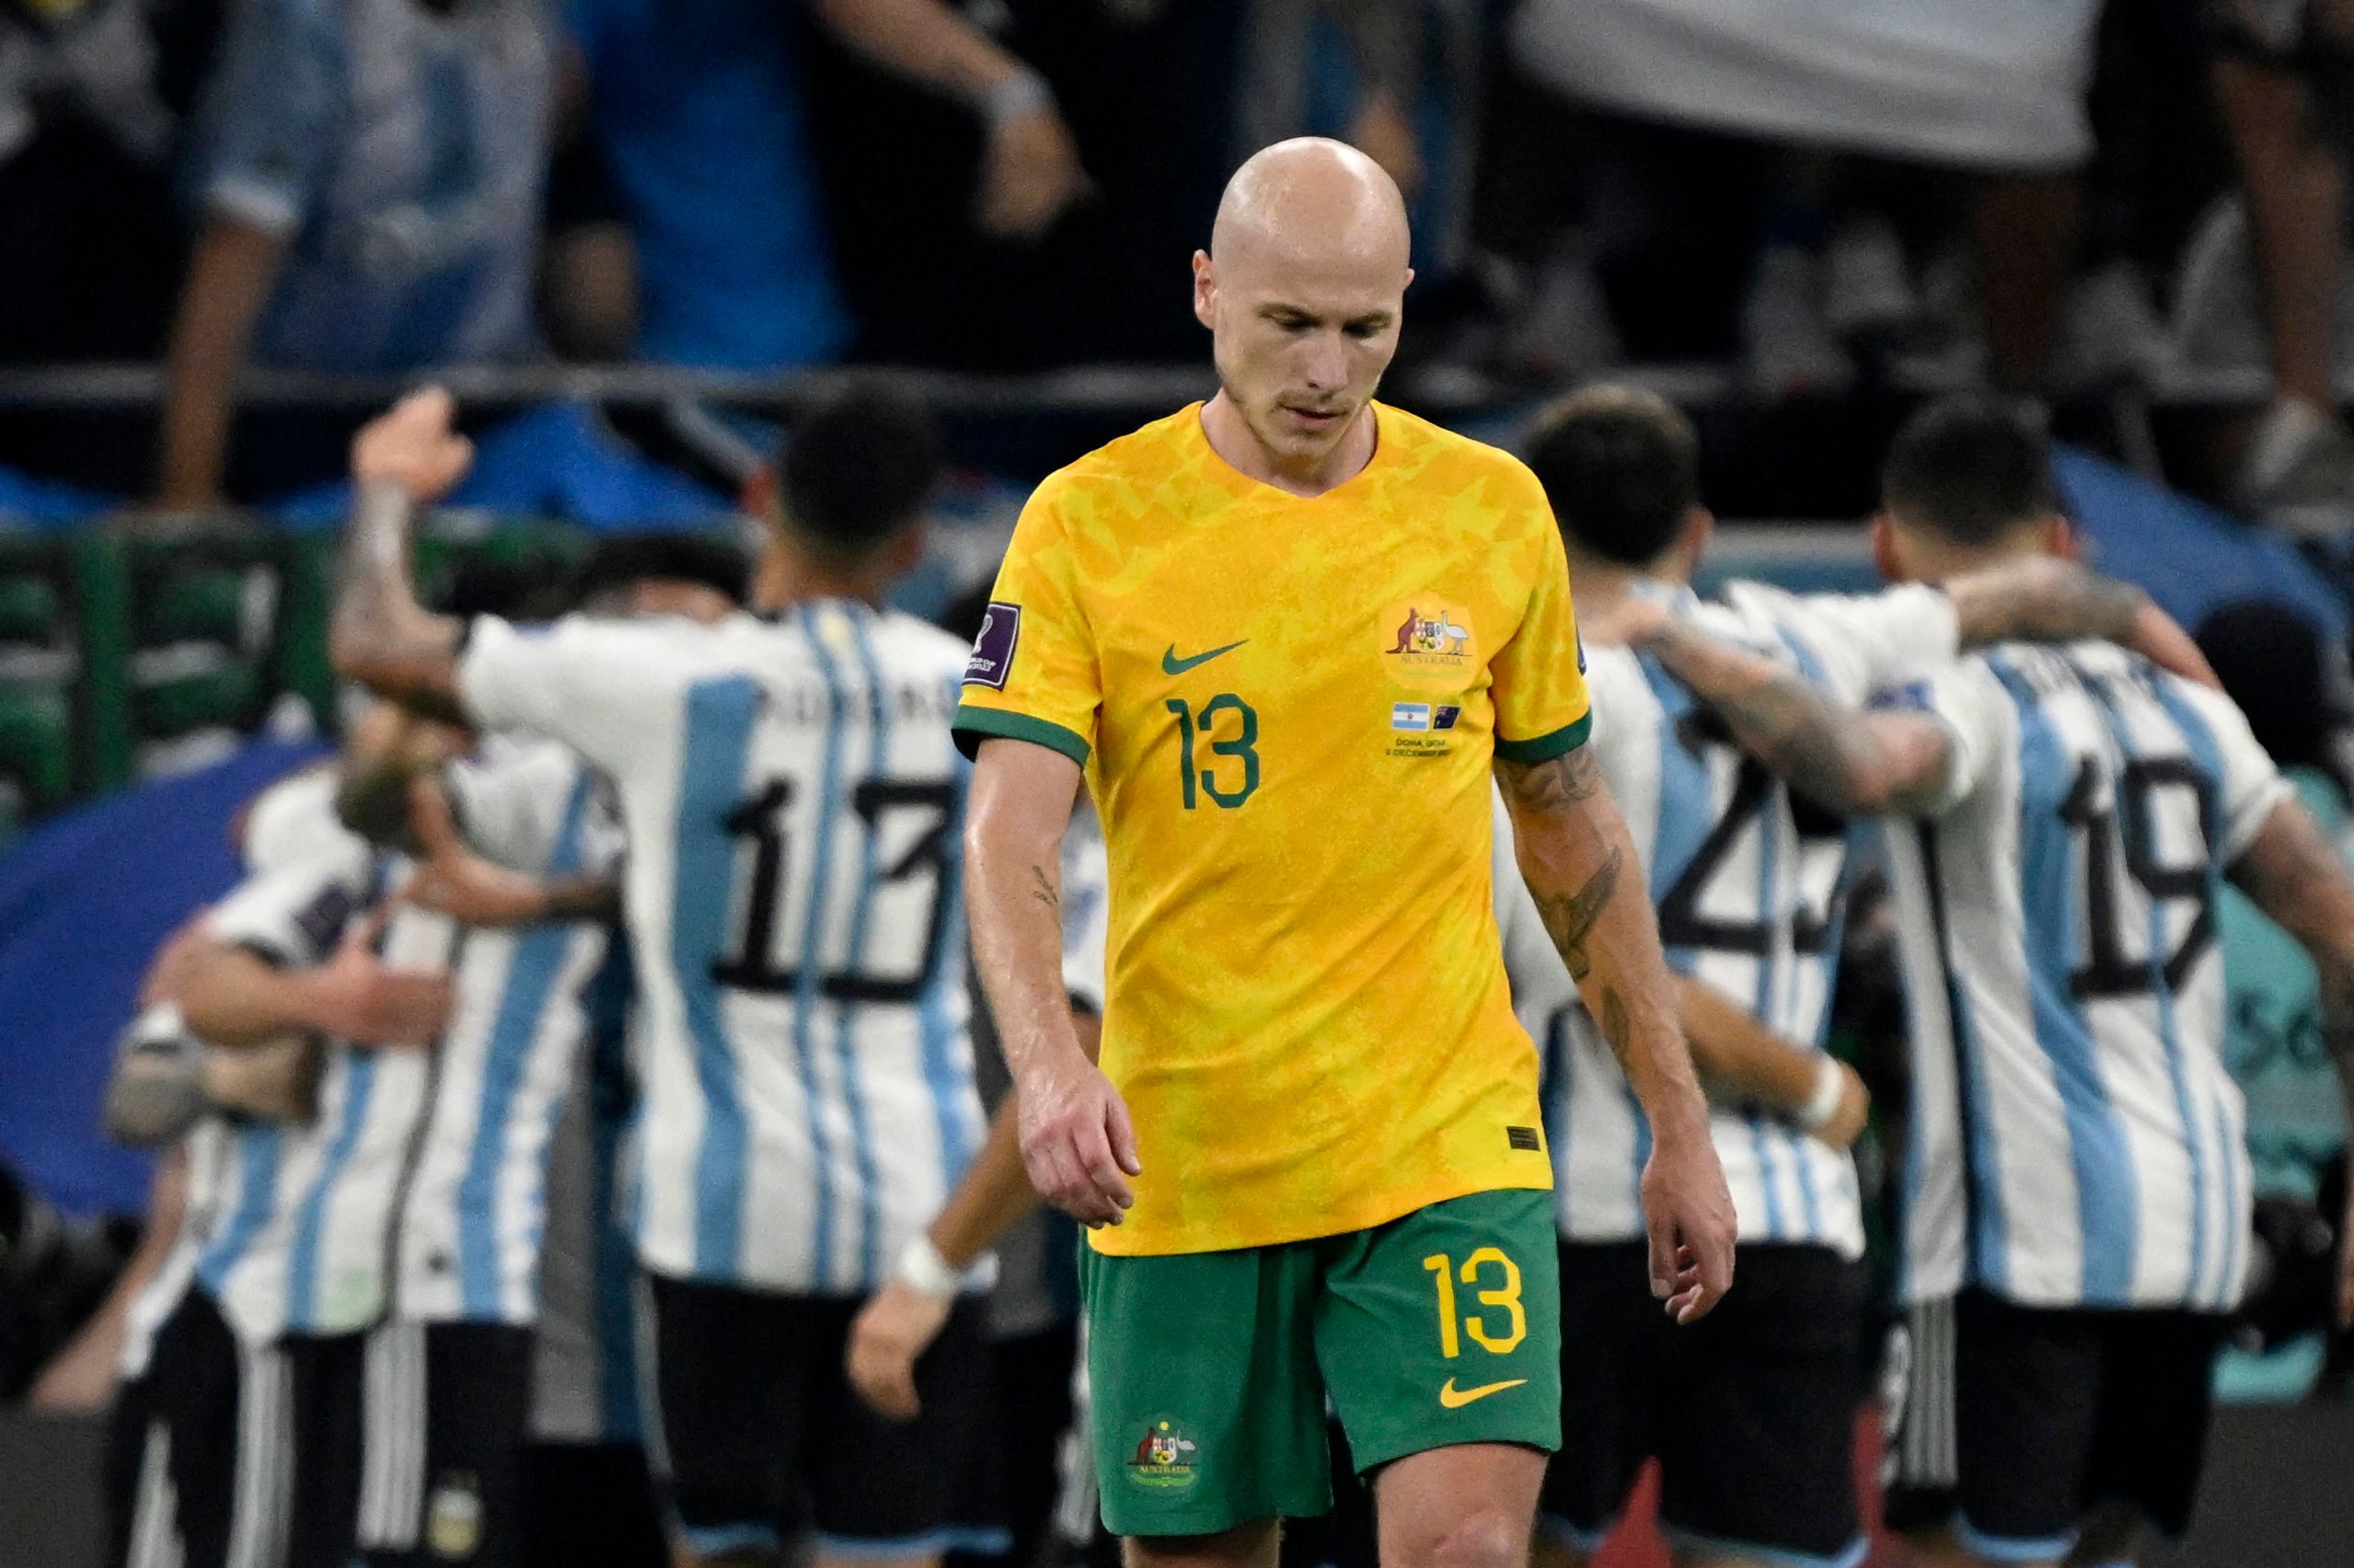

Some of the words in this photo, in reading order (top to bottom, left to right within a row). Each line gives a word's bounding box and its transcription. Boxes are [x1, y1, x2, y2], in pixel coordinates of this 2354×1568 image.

[1401, 654, 1463, 665] AUSTRALIA
[1165, 693, 1260, 809] 13
[707, 775, 957, 1001] 13
[2058, 755, 2216, 998] 19
[1424, 1247, 1527, 1358] 13
